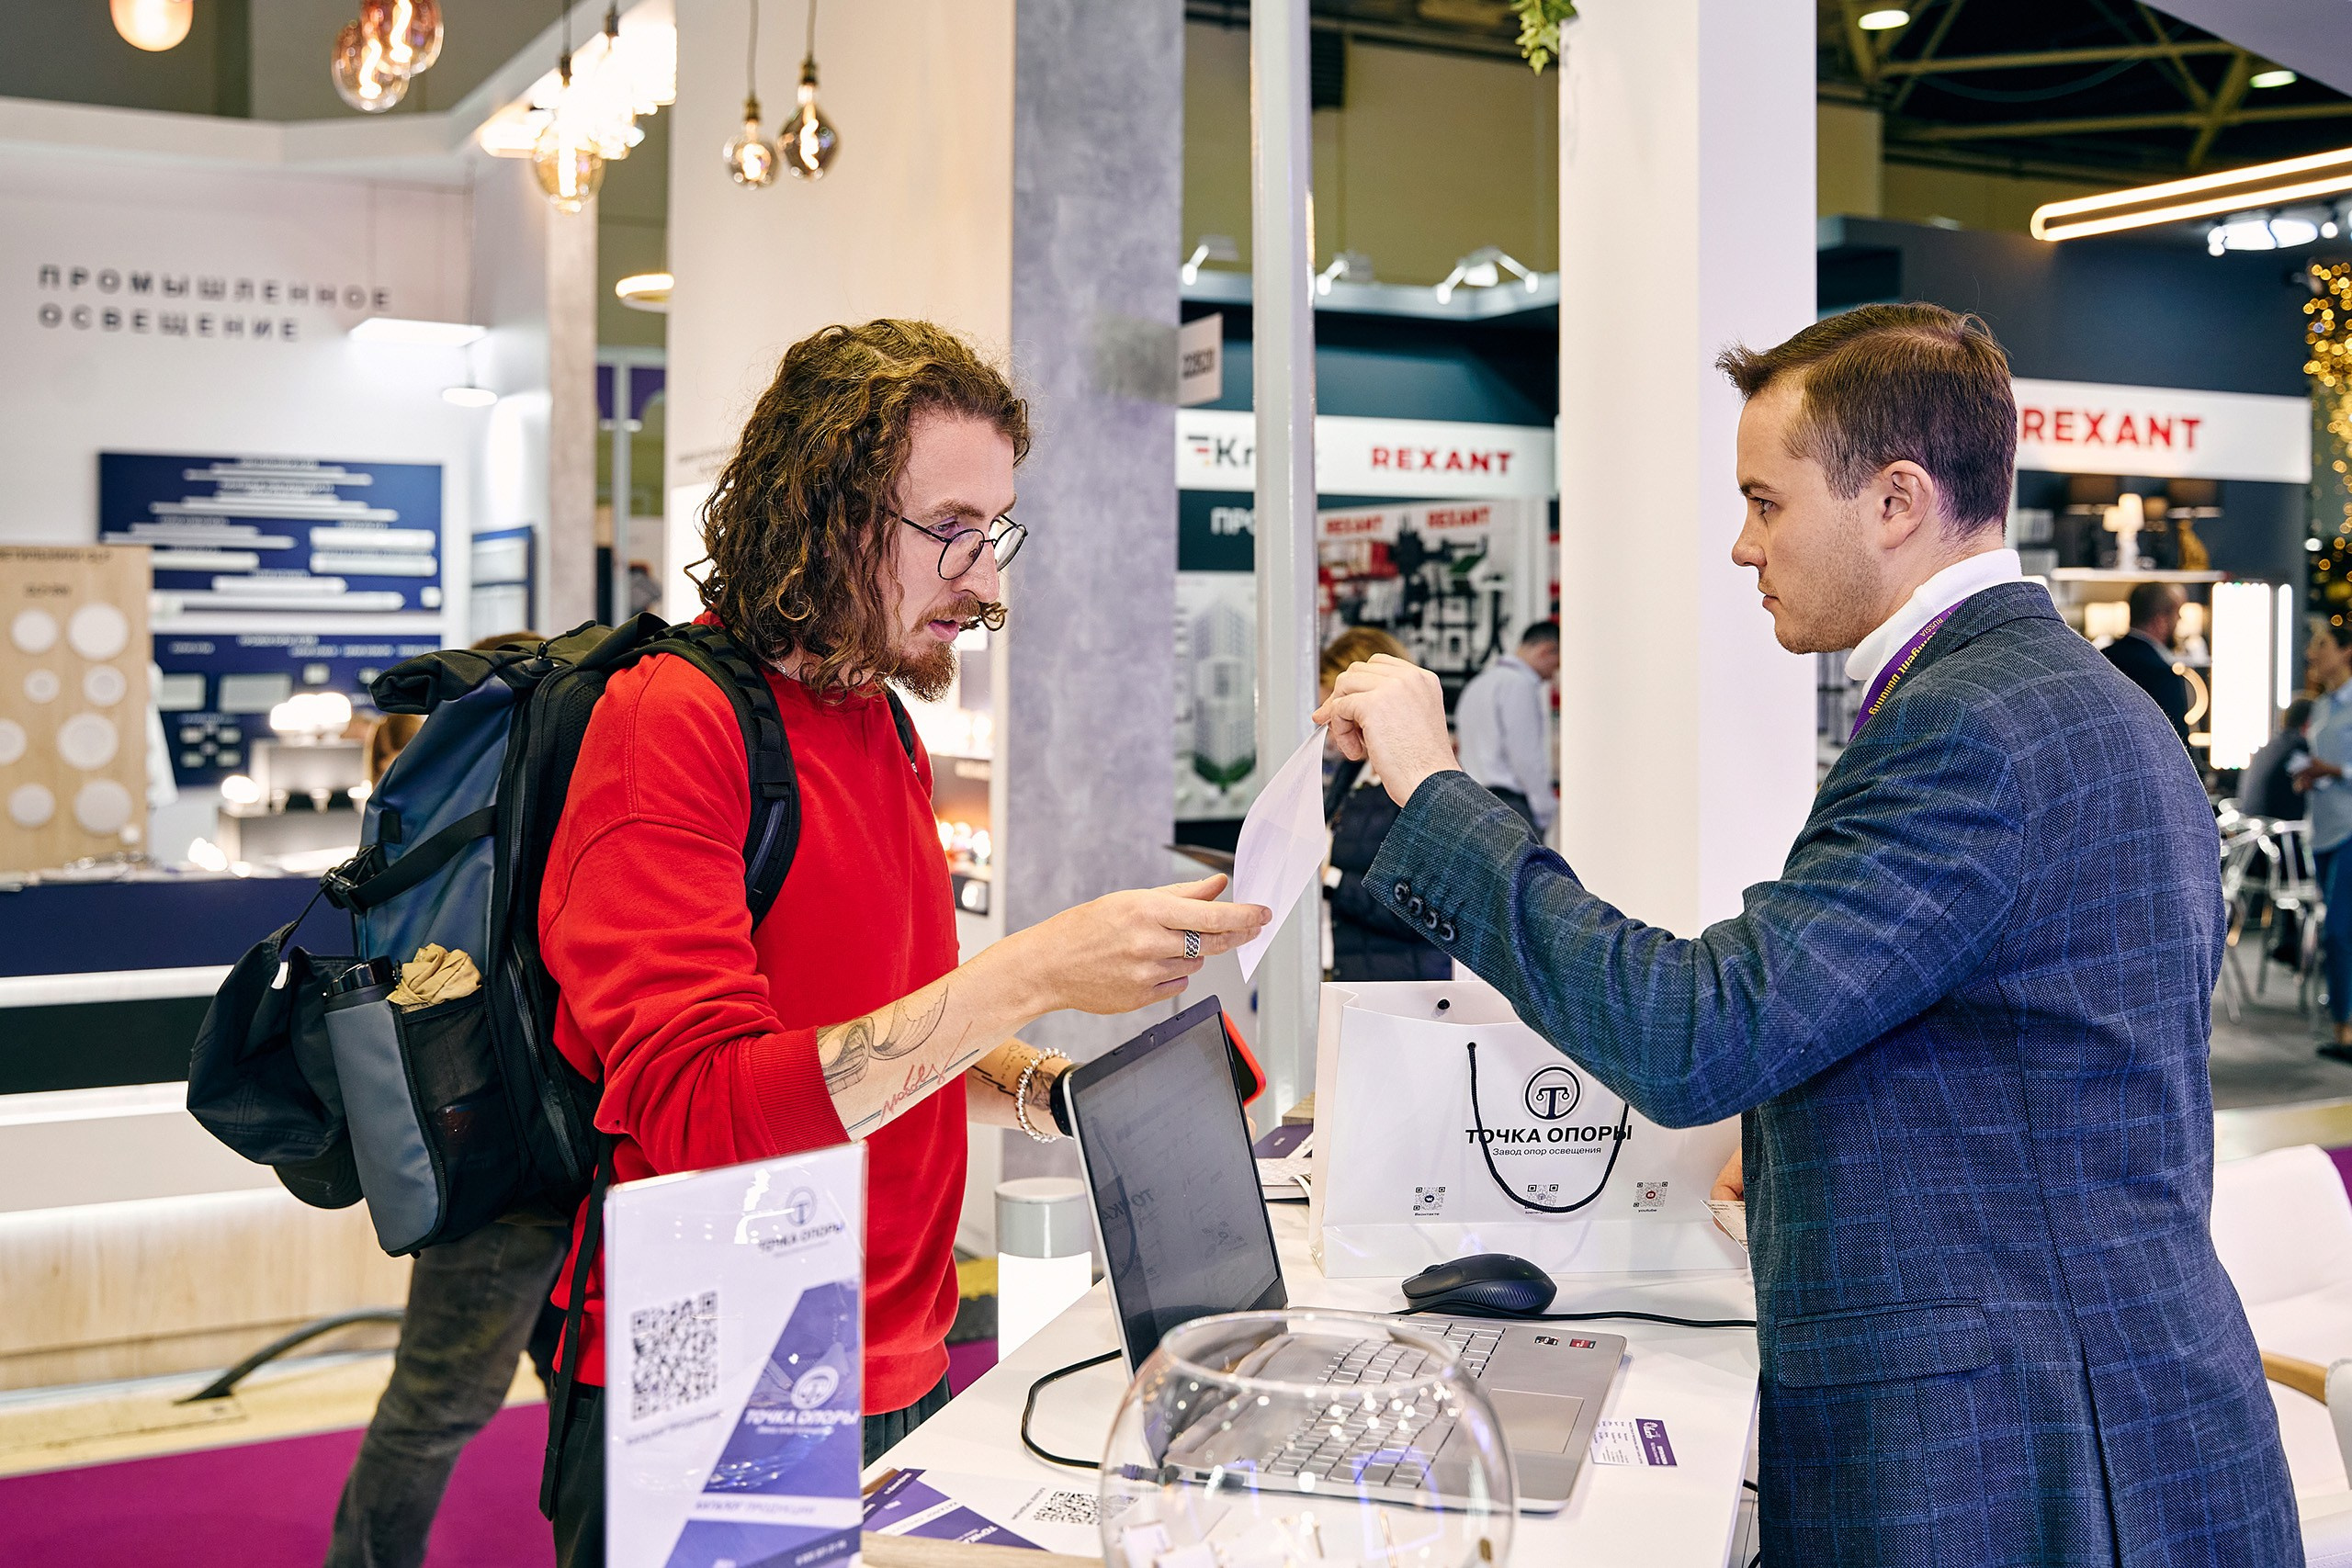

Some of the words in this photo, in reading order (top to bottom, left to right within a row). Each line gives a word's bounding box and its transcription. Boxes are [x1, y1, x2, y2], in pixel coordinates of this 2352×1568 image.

[38, 263, 391, 310] ПРОМЫШЛЕННОЕ
[38, 302, 300, 343] ОСВЕЩЕНИЕ
[2021, 408, 2204, 451] REXANT
[1372, 446, 1514, 474] REXANT
[1919, 616, 1944, 637] RUSSIA
[1465, 1128, 1542, 1145] ТОЧКА
[1547, 1125, 1633, 1143] ОПОРЫ
[1492, 1147, 1522, 1156] Завод
[1523, 1148, 1548, 1156] опор
[1549, 1146, 1601, 1155] освещения
